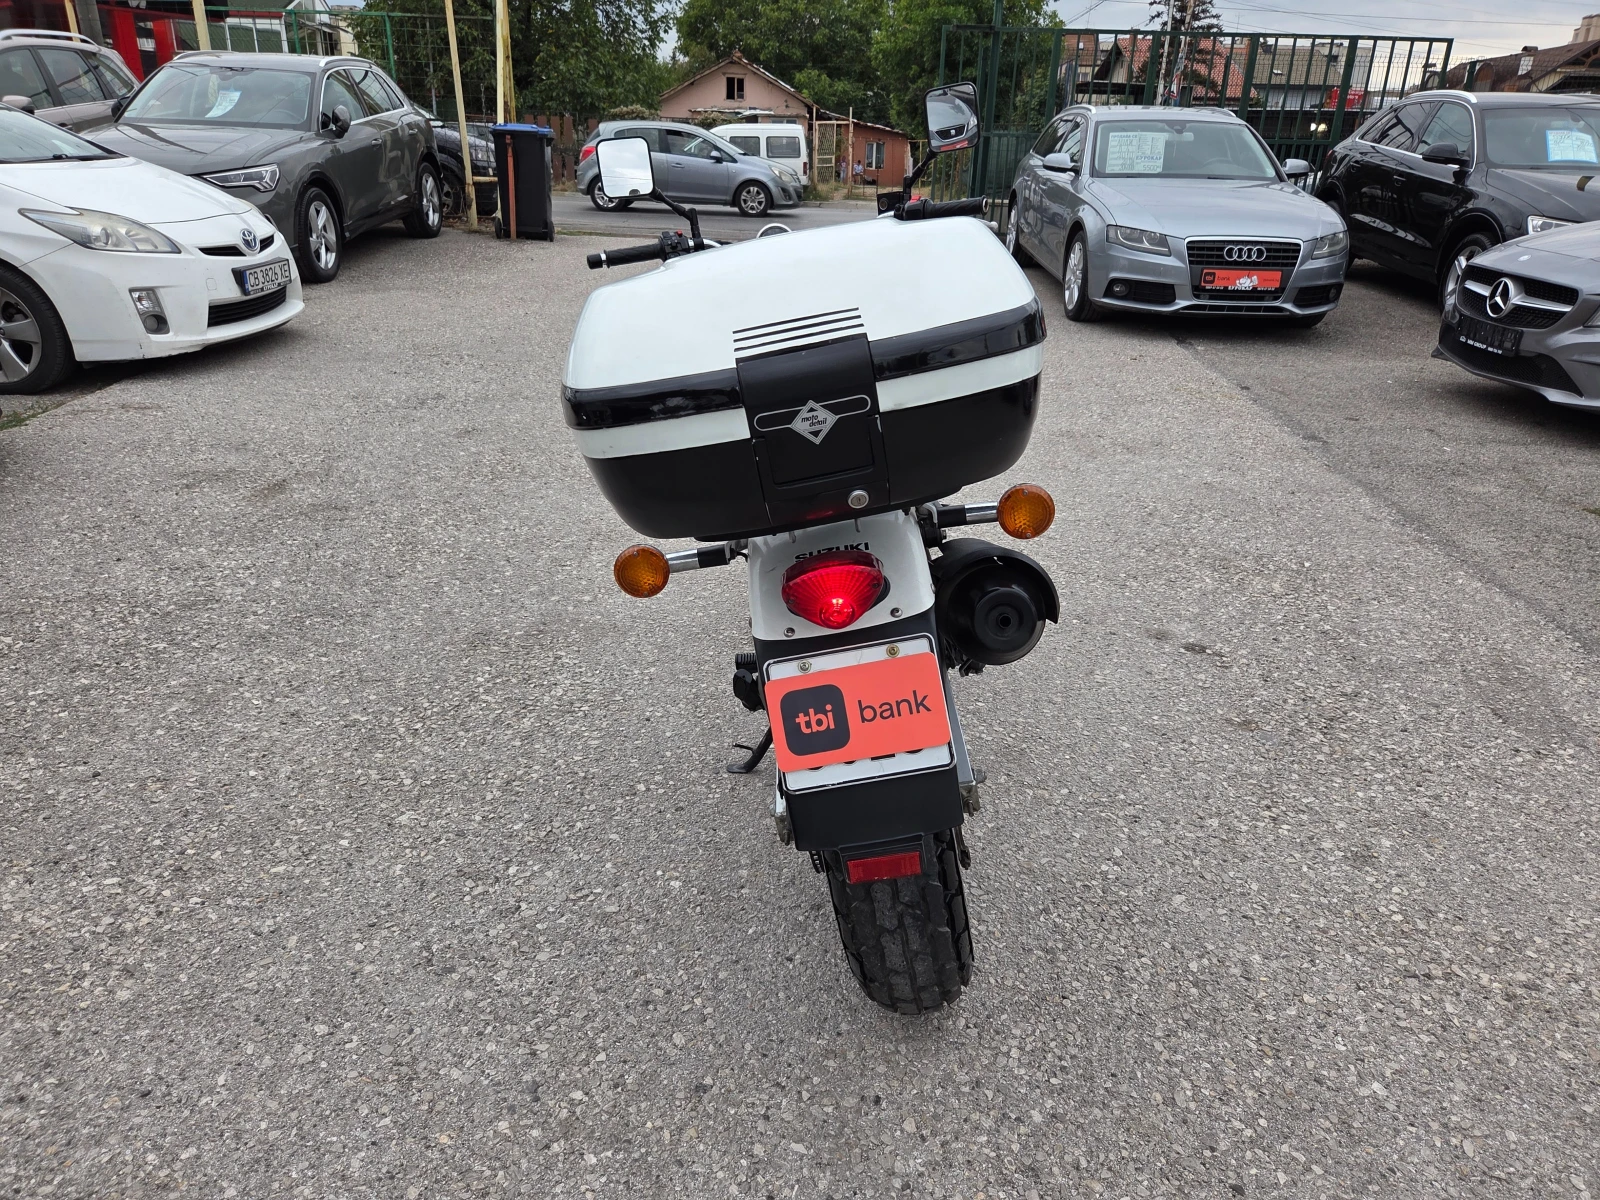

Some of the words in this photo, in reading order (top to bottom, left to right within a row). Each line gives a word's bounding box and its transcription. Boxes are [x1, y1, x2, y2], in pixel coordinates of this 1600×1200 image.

[249, 270, 260, 287] CB
[260, 266, 279, 285] 3826
[279, 263, 289, 280] XE
[801, 414, 819, 423] moto
[809, 417, 827, 428] detail
[795, 704, 835, 734] tbi
[857, 690, 932, 723] bank
